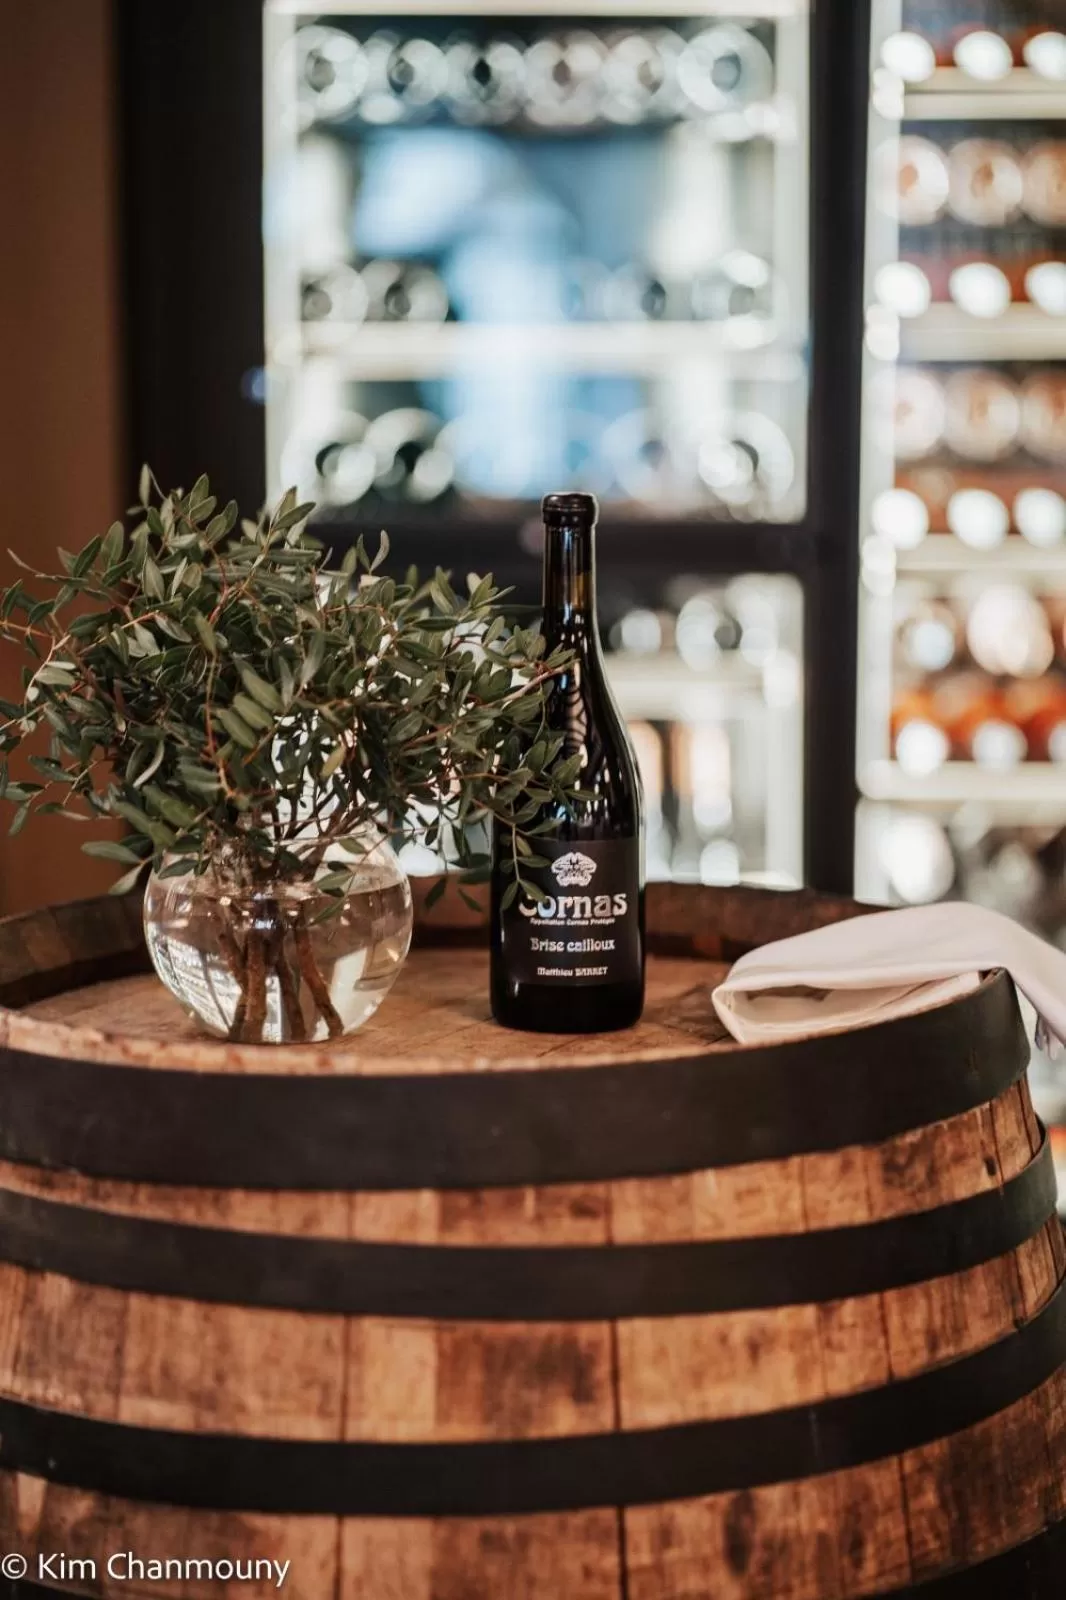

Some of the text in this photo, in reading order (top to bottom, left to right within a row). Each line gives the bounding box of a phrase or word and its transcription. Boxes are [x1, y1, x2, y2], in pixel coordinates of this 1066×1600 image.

[530, 937, 616, 952] Brise cailloux
[537, 966, 608, 977] Matthieu BARRET
